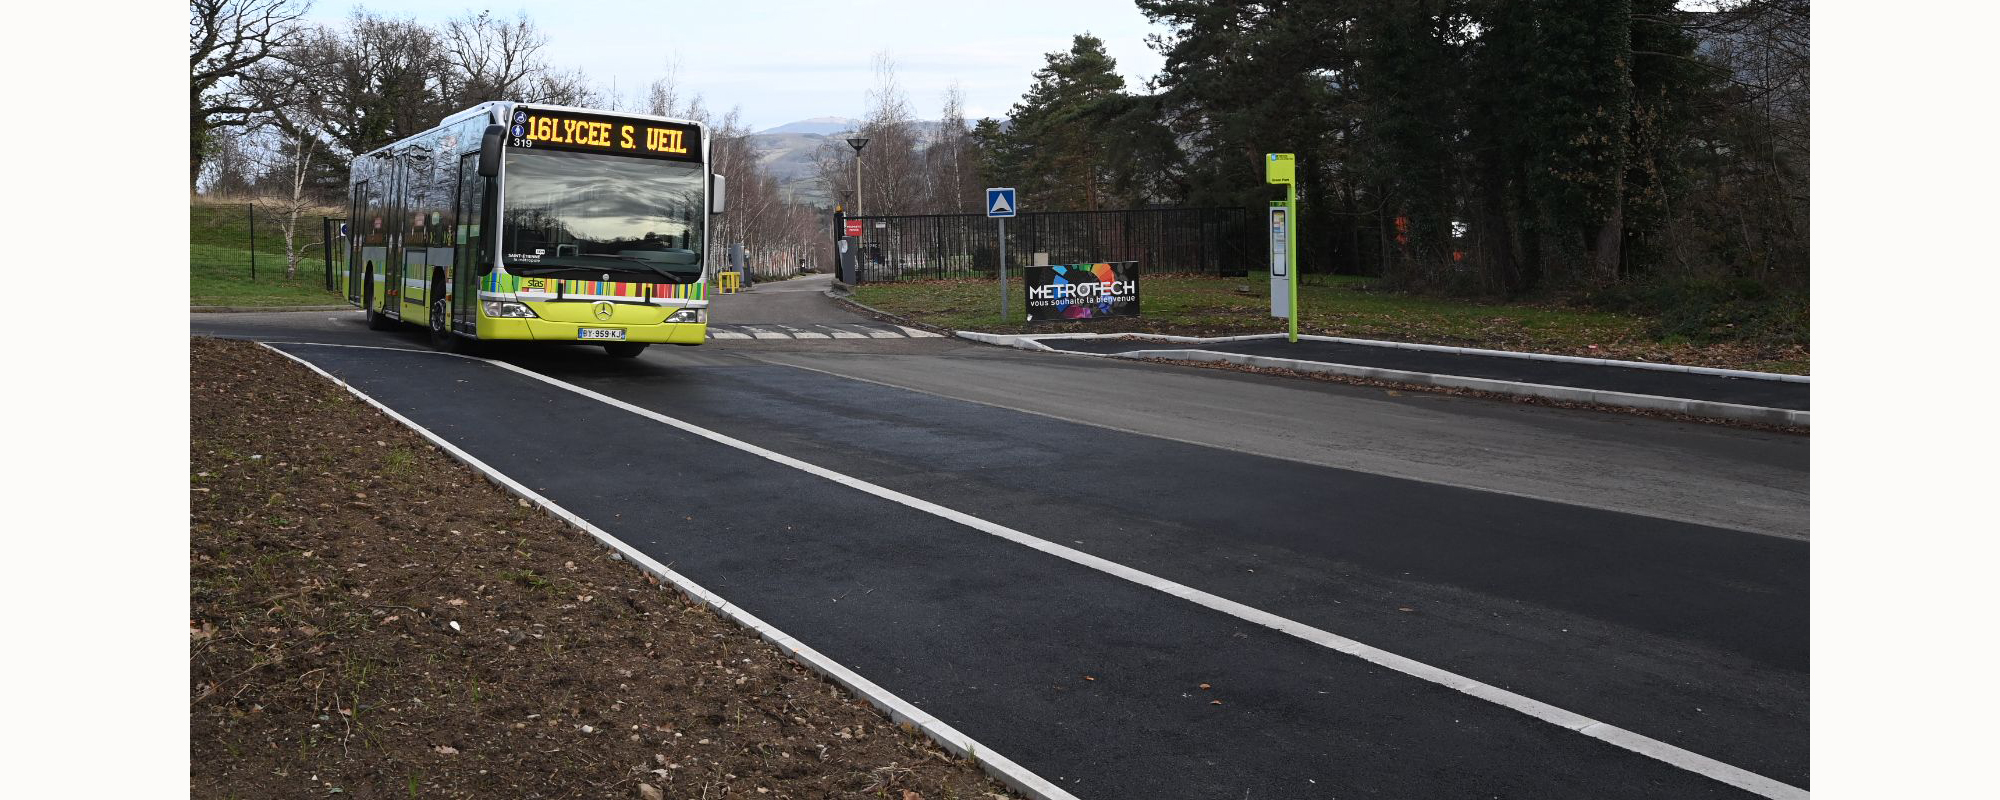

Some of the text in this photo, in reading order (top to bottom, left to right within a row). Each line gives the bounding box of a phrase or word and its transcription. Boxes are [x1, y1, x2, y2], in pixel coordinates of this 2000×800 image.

[513, 137, 532, 148] 319
[620, 125, 637, 149] S.
[527, 278, 544, 288] stas
[1029, 280, 1135, 300] METROTECH
[1050, 297, 1085, 306] souhaite
[1086, 296, 1094, 304] la
[1096, 295, 1136, 303] bienvenue
